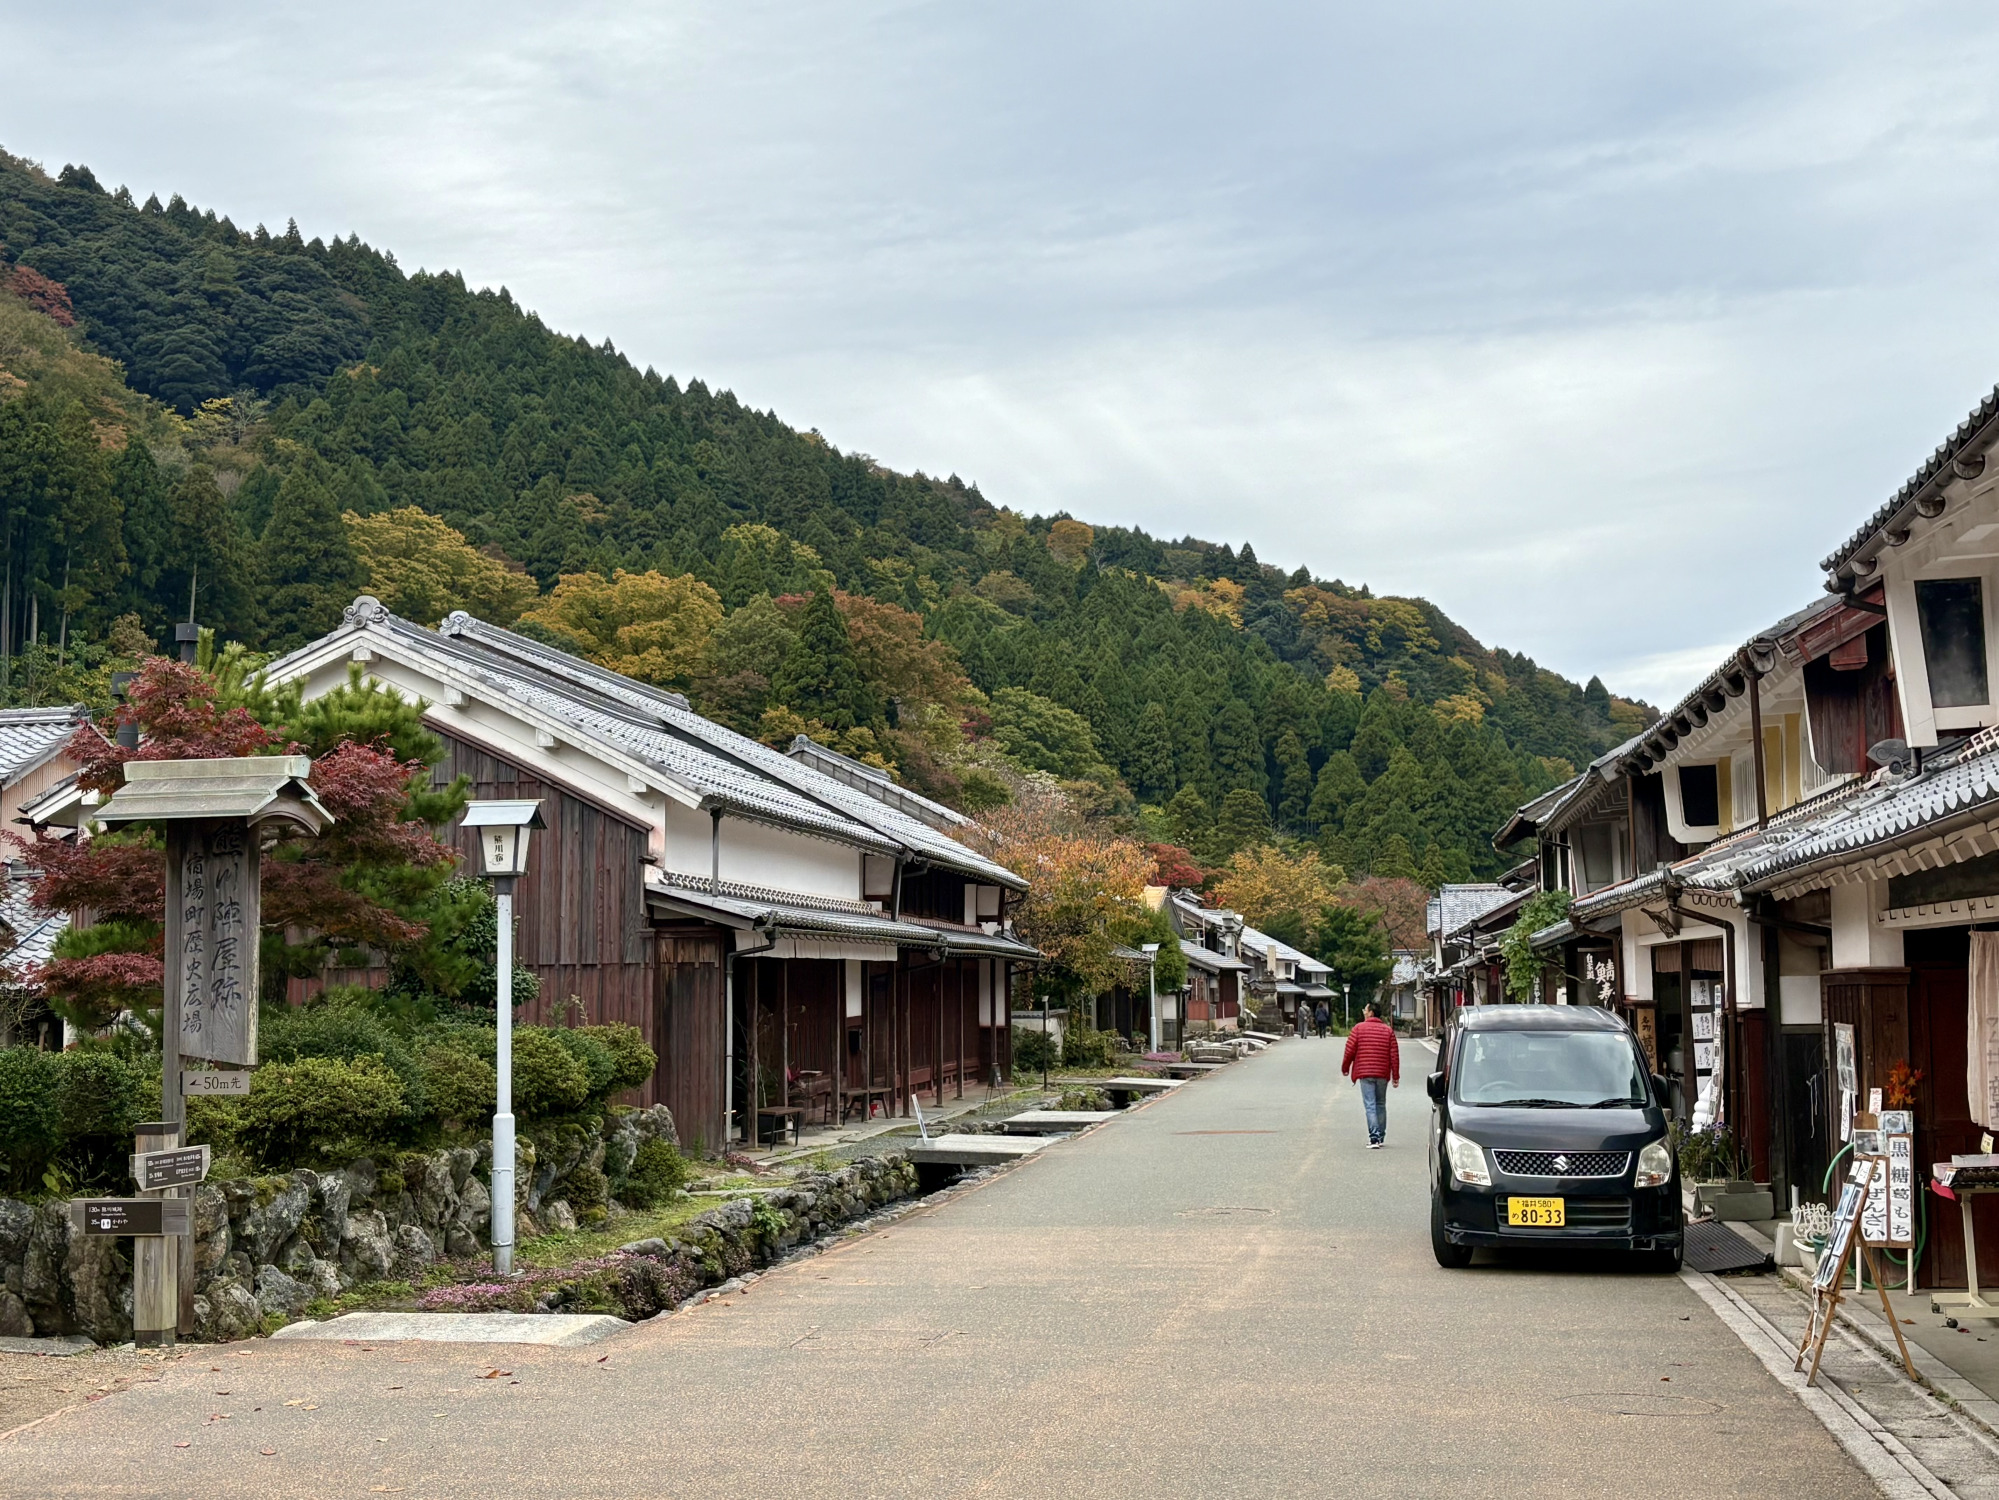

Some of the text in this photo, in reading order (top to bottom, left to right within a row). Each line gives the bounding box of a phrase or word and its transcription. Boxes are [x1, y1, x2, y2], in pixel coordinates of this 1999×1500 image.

[494, 835, 503, 862] 熊川宿
[182, 852, 204, 1033] 宿場町歴史広場
[203, 1076, 242, 1090] 50m先
[1890, 1141, 1910, 1238] 黒糖葛もち
[1521, 1209, 1562, 1223] 80-33
